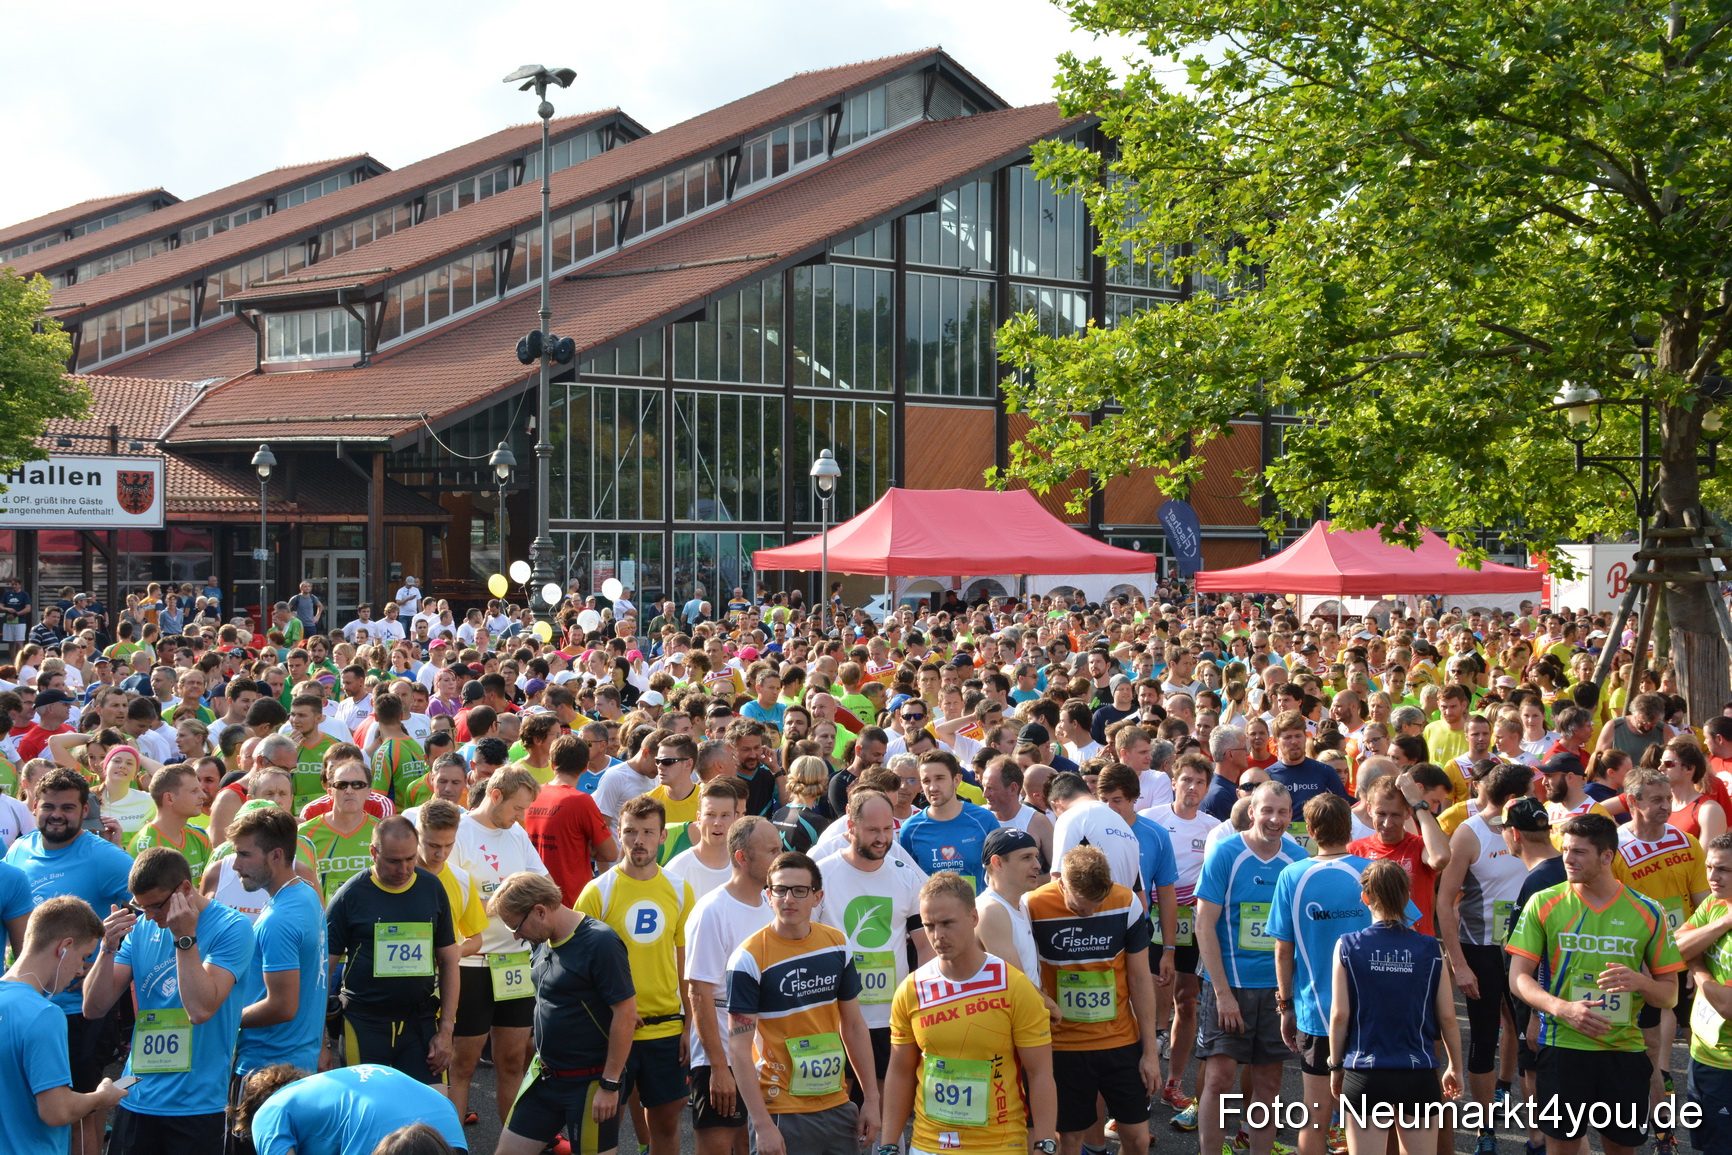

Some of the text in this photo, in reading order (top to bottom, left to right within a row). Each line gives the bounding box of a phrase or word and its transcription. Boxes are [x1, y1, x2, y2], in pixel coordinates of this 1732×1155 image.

[6, 465, 102, 486] Hallen
[13, 496, 32, 504] OPf.
[34, 496, 58, 505] grüßt
[60, 497, 77, 505] ihre
[79, 497, 104, 505] Gäste
[8, 507, 114, 516] angenehmen Aufenthalt!
[932, 859, 964, 869] camping
[1631, 851, 1695, 881] MAX BÖGL
[30, 876, 48, 888] chick
[634, 908, 658, 935] B
[1250, 922, 1272, 937] 52
[1062, 935, 1113, 948] Fischer
[1067, 945, 1110, 953] AUTOMOBILE
[1558, 932, 1638, 957] BOCK
[387, 944, 423, 961] 784
[153, 954, 177, 973] Schic
[505, 969, 522, 986] 95
[791, 973, 838, 993] Fischer
[797, 985, 835, 998] AUTOMOBILE
[1063, 991, 1111, 1008] 1638
[920, 997, 1011, 1029] MAX BÖGL
[143, 1034, 179, 1055] 806
[800, 1056, 841, 1079] 1623
[934, 1082, 973, 1107] 891
